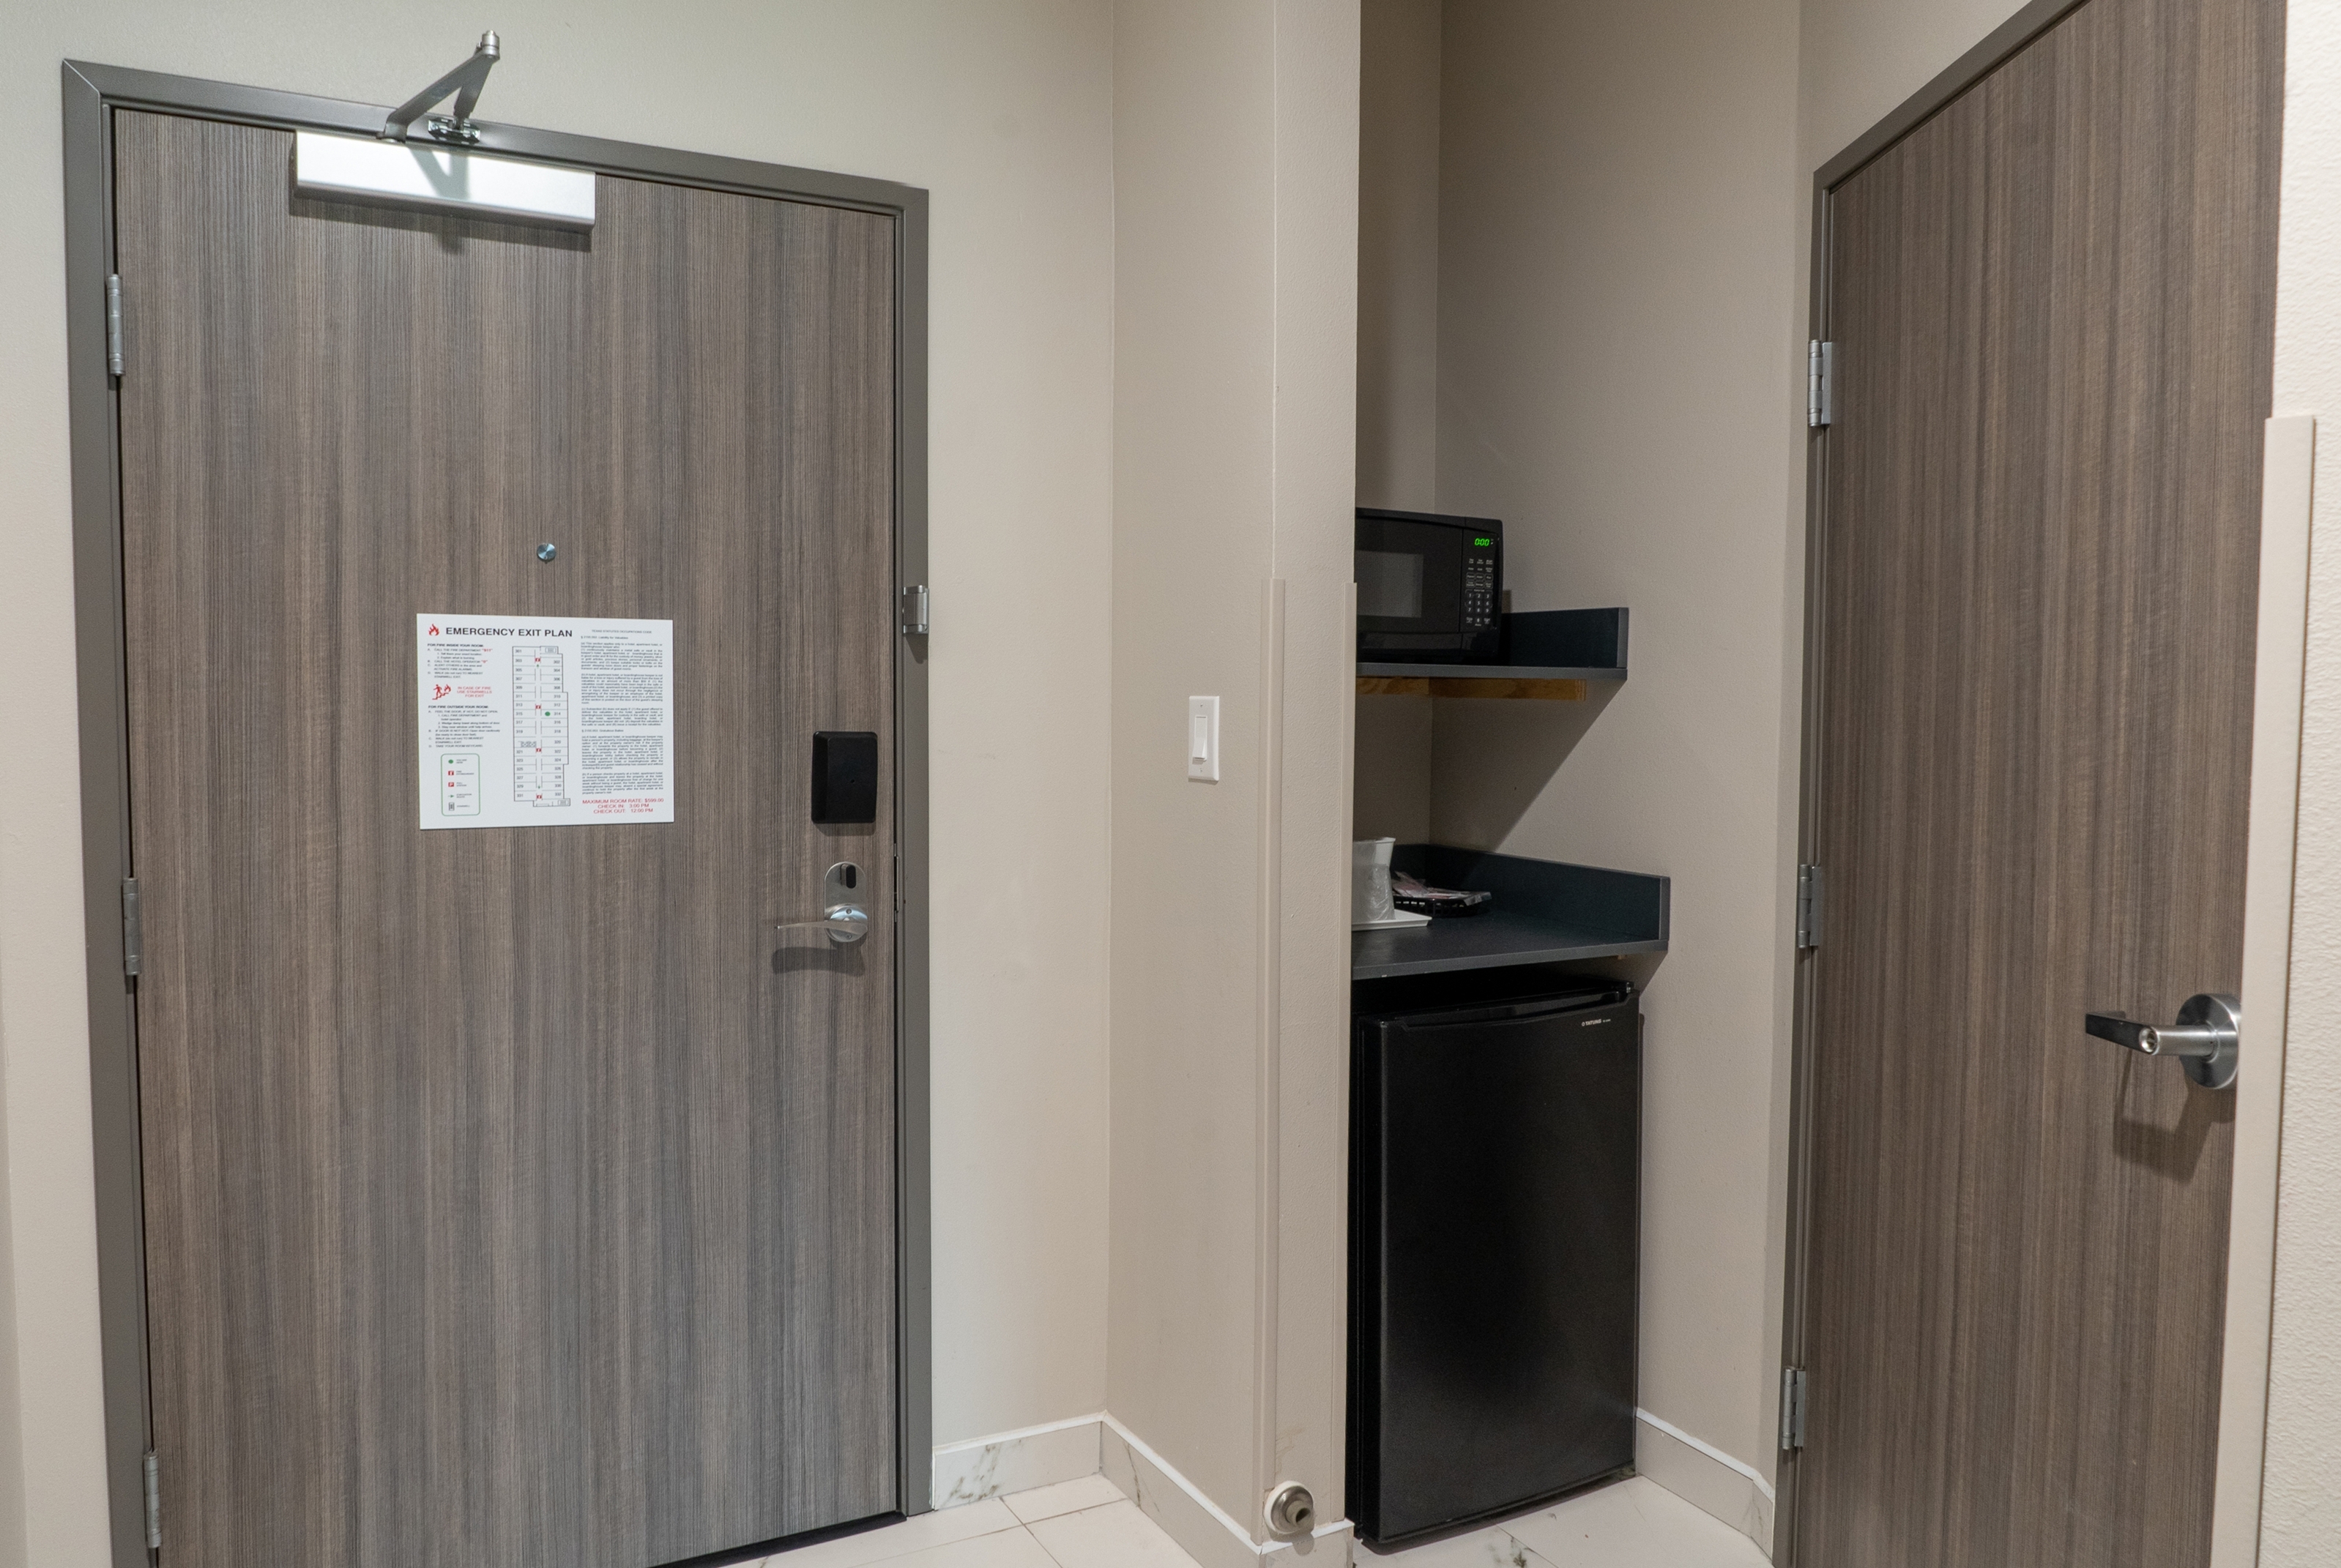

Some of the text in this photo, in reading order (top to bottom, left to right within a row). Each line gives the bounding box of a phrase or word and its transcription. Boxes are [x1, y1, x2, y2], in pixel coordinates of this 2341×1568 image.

[446, 627, 515, 636] EMERGENCY
[518, 628, 542, 637] EXIT
[545, 629, 572, 637] PLAN
